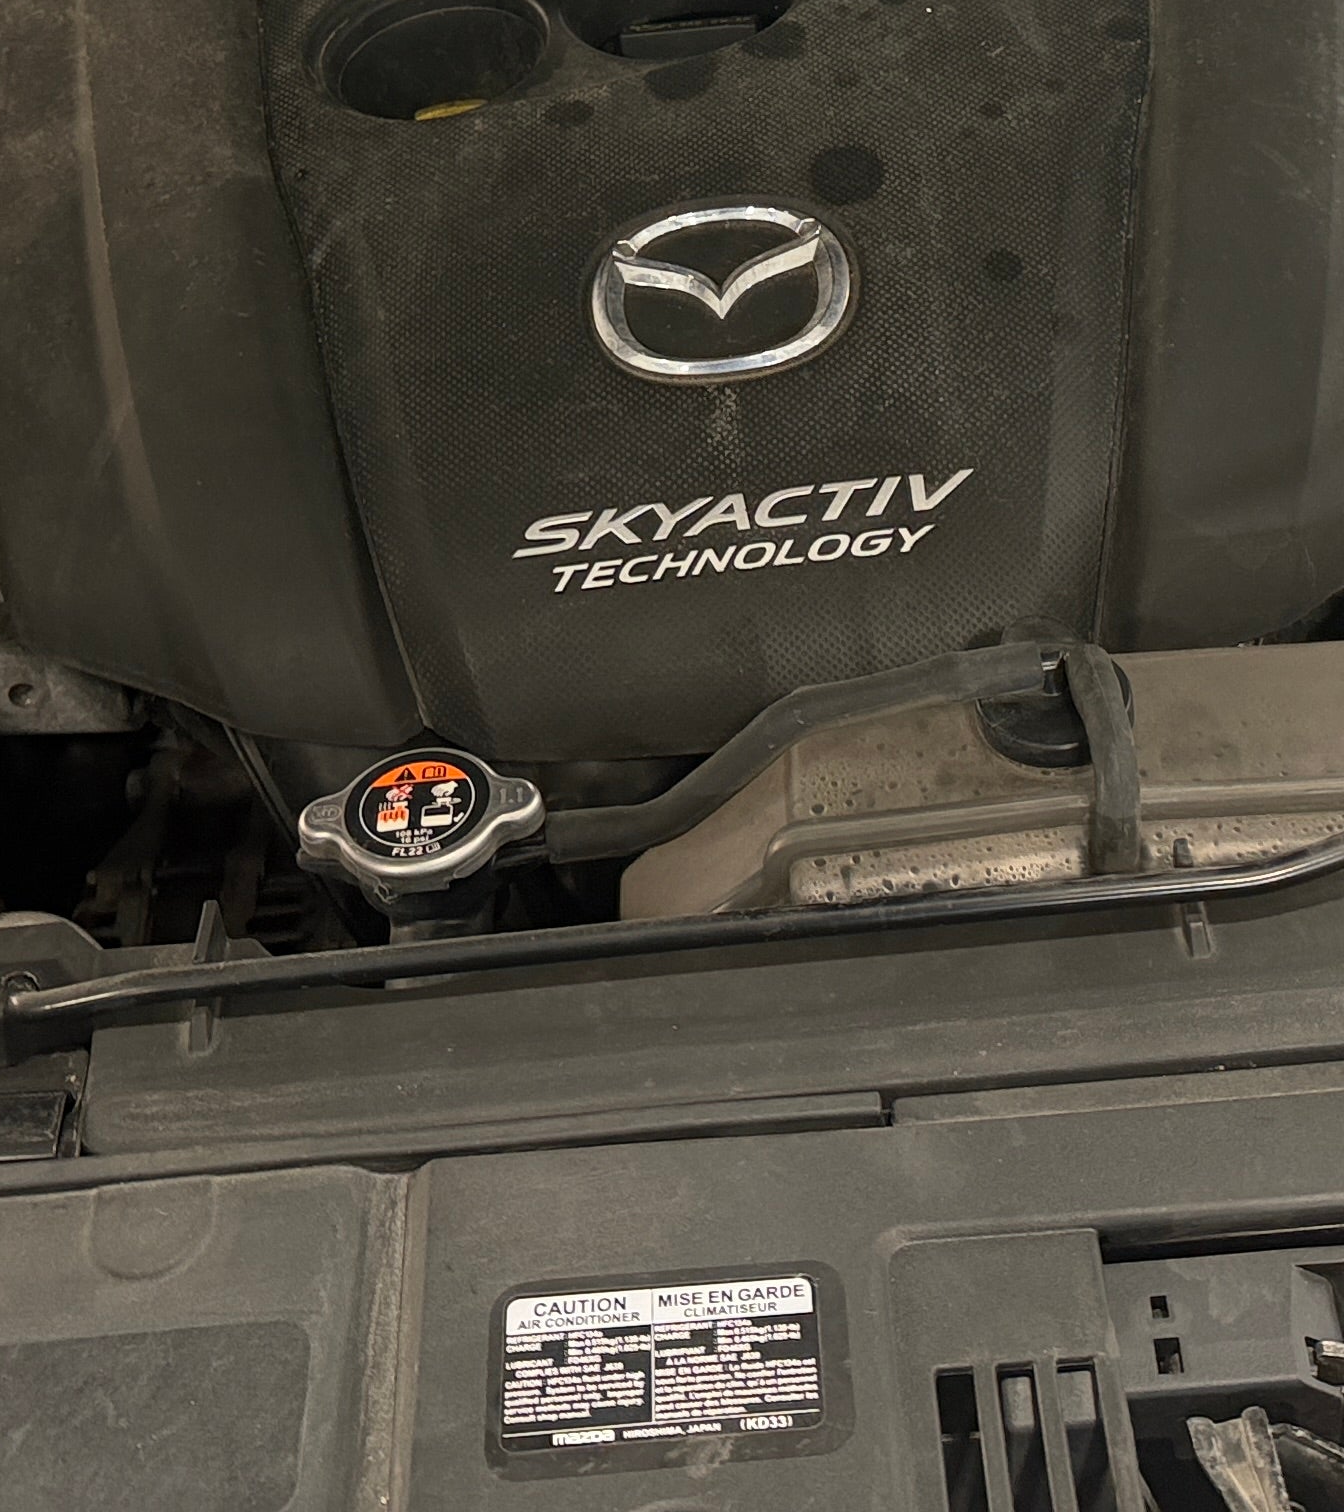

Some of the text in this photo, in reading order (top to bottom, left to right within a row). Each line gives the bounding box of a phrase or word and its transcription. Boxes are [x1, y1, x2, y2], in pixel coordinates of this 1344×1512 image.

[512, 468, 975, 559] SKYACTIV
[553, 524, 935, 593] TECHNOLOGY
[533, 1296, 627, 1317] CAUTION
[658, 1284, 806, 1308] MISE EN GARDE
[683, 1301, 778, 1318] CLIMATISEUR
[517, 1312, 641, 1330] AIR CONDITIONER
[739, 1415, 793, 1431] (KD33)
